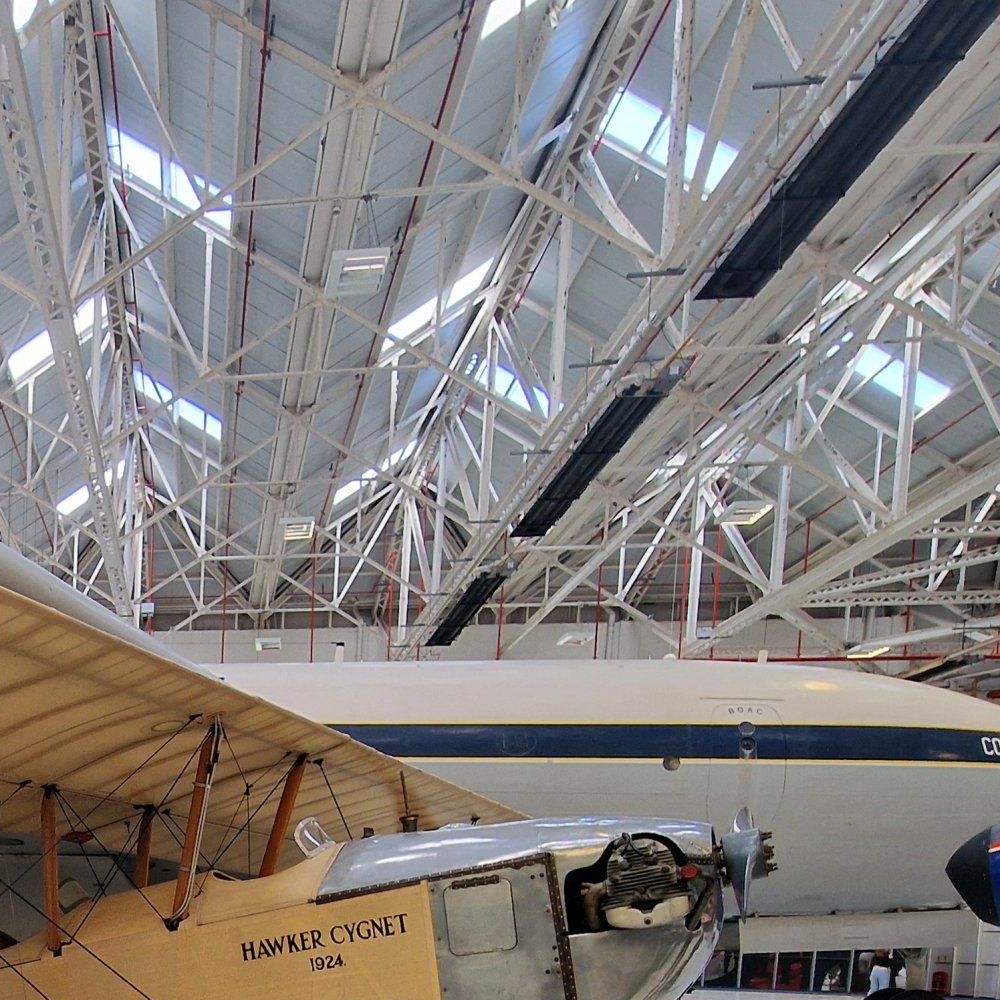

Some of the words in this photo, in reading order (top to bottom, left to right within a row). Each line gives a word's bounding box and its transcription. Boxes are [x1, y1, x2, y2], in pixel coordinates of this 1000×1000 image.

[728, 706, 763, 715] BOAC
[241, 929, 325, 962] HAWKER
[330, 913, 408, 945] CYGNET
